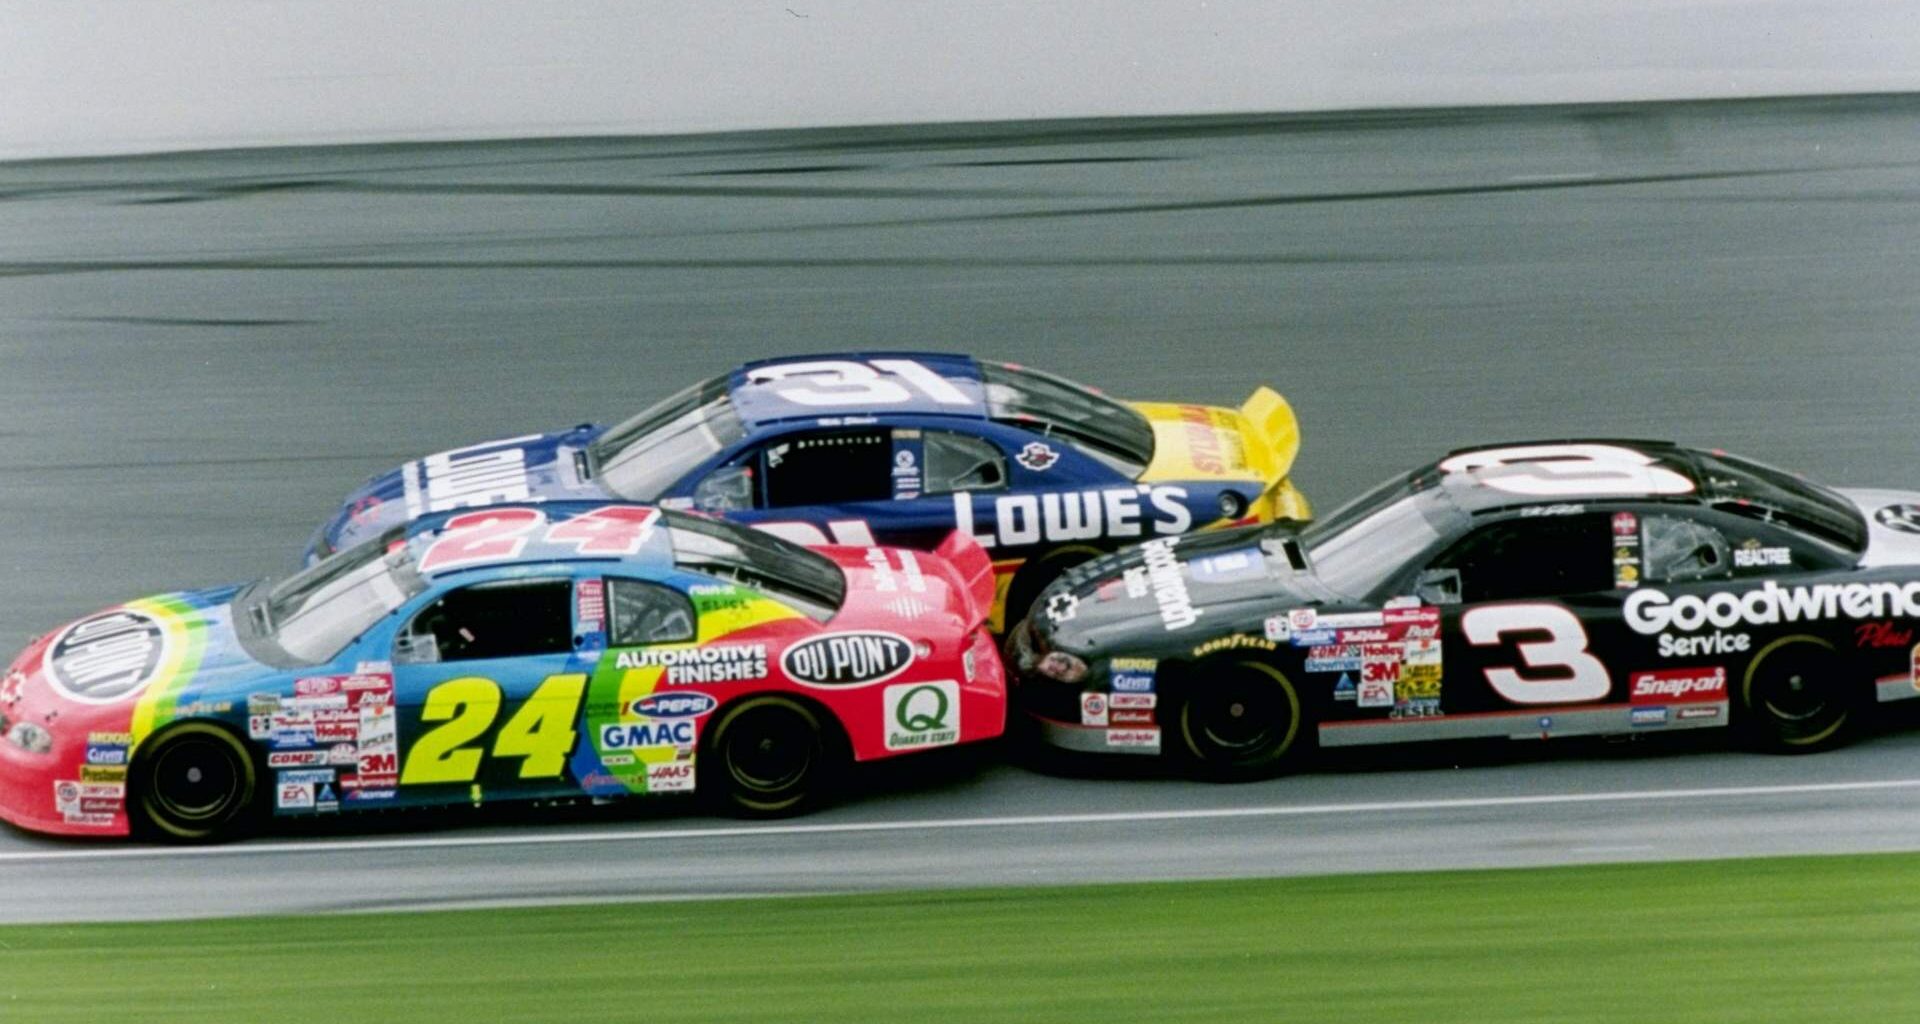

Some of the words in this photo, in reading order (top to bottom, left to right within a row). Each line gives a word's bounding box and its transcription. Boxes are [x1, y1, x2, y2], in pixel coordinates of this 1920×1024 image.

[747, 359, 974, 405] 31
[1439, 443, 1696, 495] 3
[953, 484, 1191, 548] LOWE'S
[418, 504, 662, 573] 24
[616, 644, 766, 669] AUTOMOTIVE
[1194, 633, 1278, 656] GOODYEAR
[1462, 604, 1612, 704] 3
[1658, 630, 1751, 657] Service
[667, 661, 768, 684] FINISHES
[1363, 661, 1399, 681] 3M
[1633, 674, 1725, 697] Snap-on
[658, 697, 708, 713] PEPSI
[896, 685, 948, 732] Q
[400, 674, 587, 784] 24
[603, 722, 692, 748] GMAC
[360, 754, 395, 773] 3M
